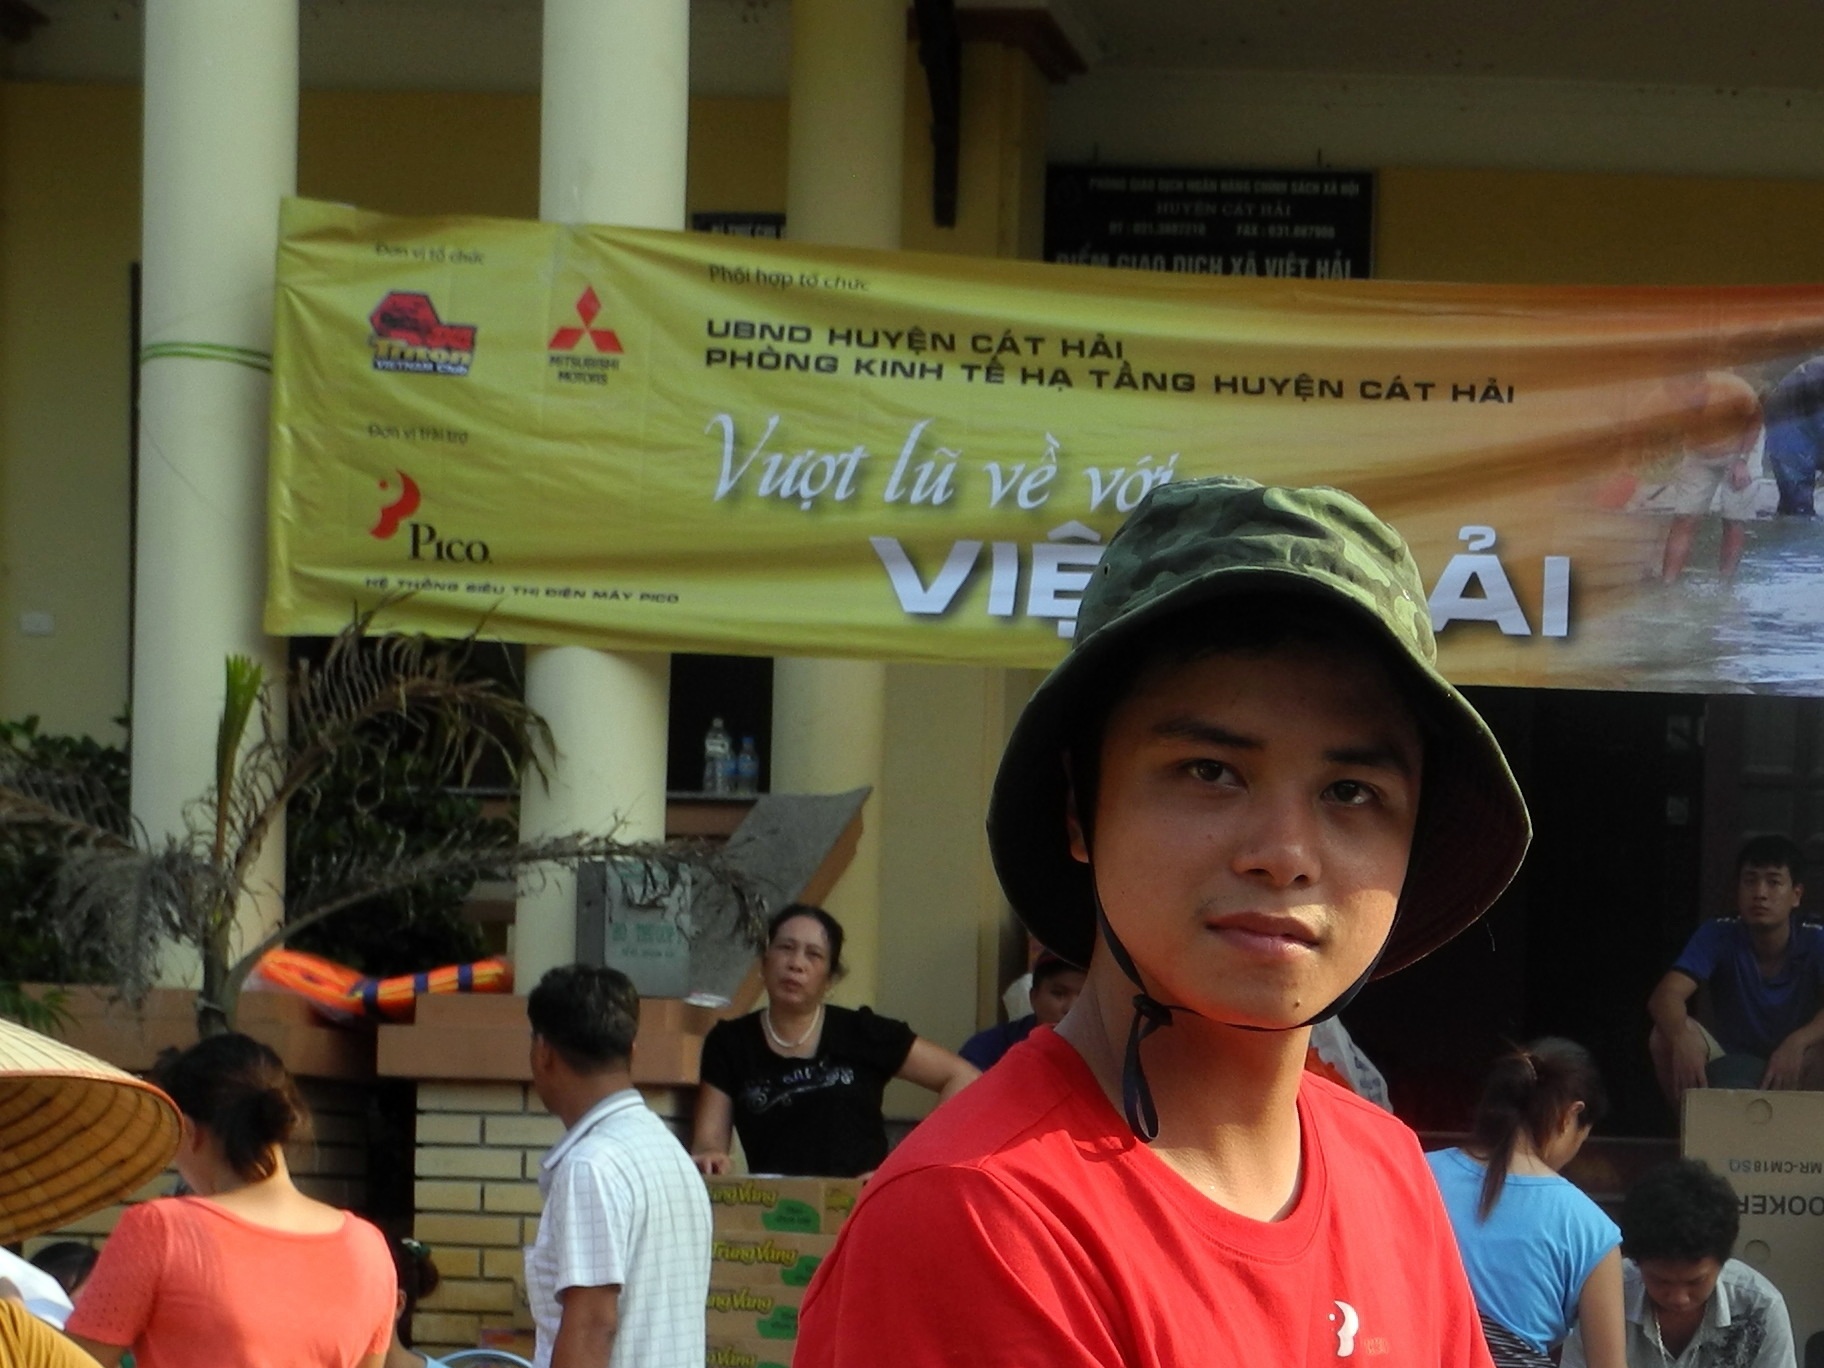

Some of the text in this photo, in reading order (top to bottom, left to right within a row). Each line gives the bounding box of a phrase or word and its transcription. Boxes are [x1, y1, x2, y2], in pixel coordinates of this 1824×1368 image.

[706, 320, 1125, 360] UBND HUYỆN CÁT HẢI
[557, 371, 608, 385] MOTORS
[705, 345, 1515, 404] PHÒNG KINH TẾ HẠ TẦNG HUYỆN CÁT HẢI
[704, 412, 870, 511] Vượt
[883, 416, 962, 507] lũ
[984, 431, 1063, 511] về
[592, 587, 634, 602] MÁY
[639, 591, 680, 604] PICO
[869, 520, 1571, 639] VIỆ ẢI
